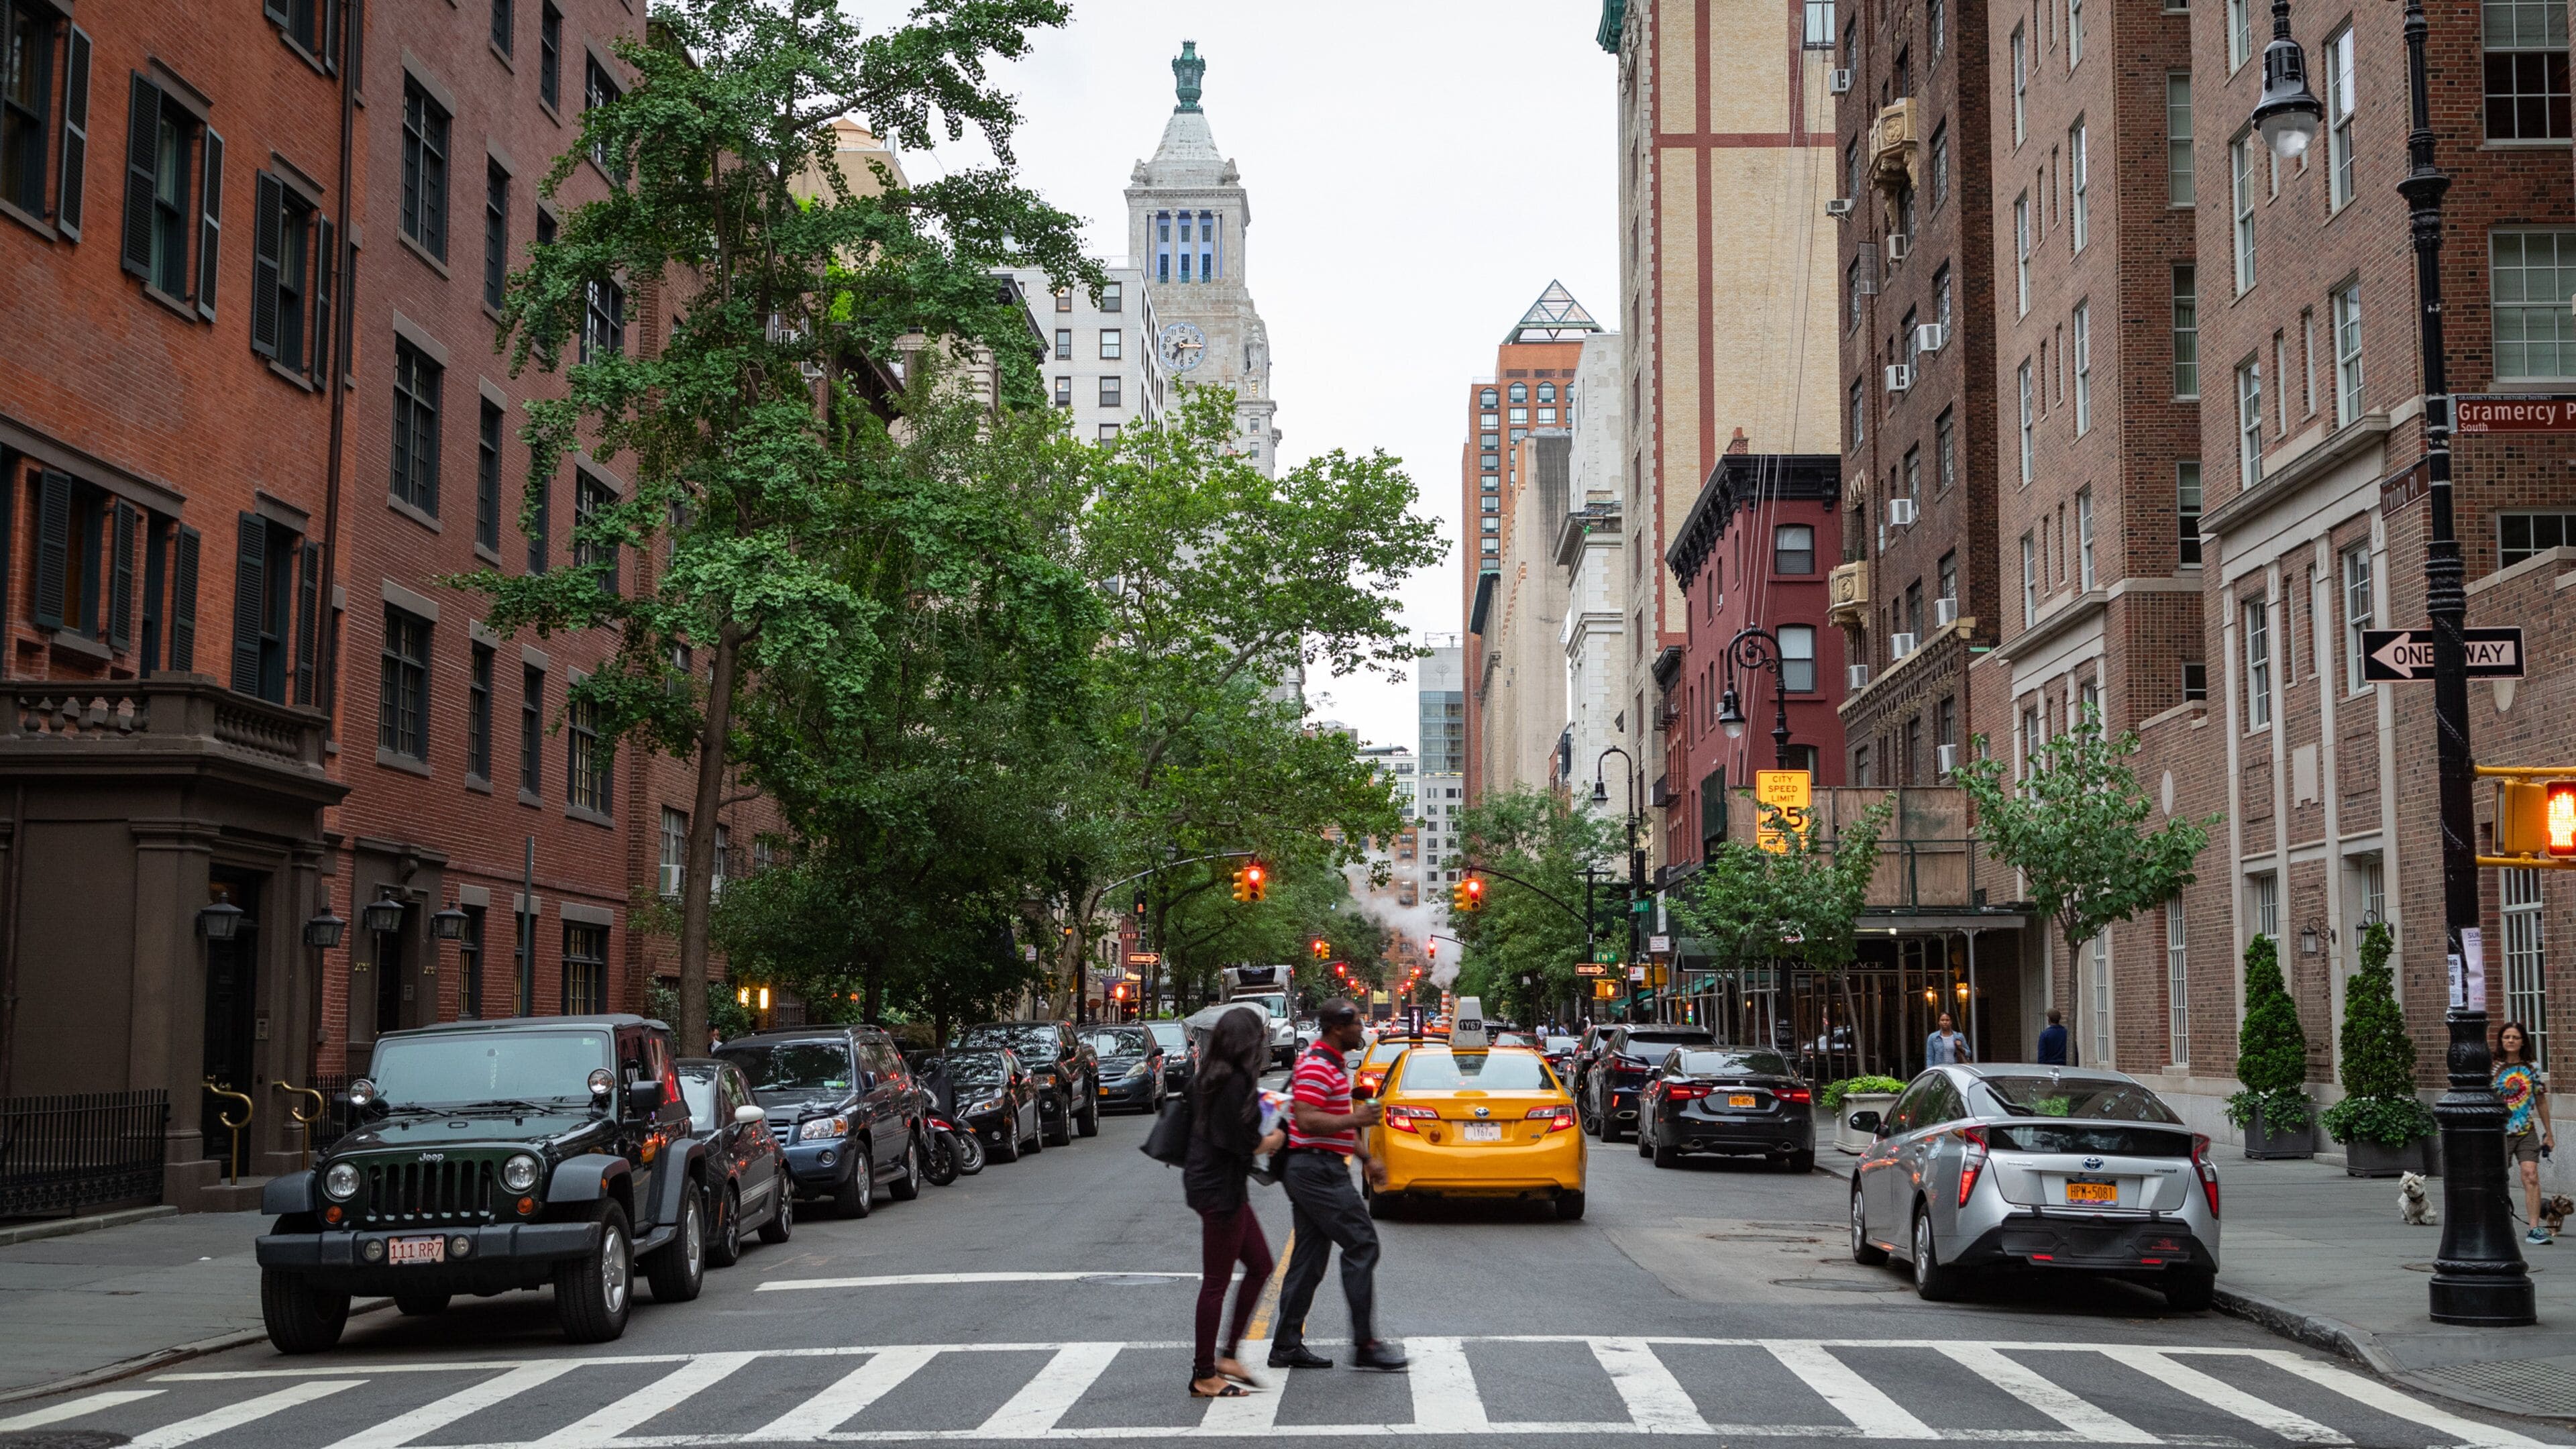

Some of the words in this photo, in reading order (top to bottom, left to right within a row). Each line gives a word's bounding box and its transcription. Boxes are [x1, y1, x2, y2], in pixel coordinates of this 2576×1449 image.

[2459, 403, 2556, 425] Gramercy
[2461, 423, 2488, 431] South
[2382, 484, 2407, 515] Irving
[2409, 472, 2418, 499] Pl
[2394, 645, 2434, 665] ONE
[2465, 644, 2505, 663] WAY
[1460, 1022, 1481, 1030] 1Y67
[419, 1152, 444, 1162] Jeep
[391, 1244, 415, 1259] 111
[419, 1242, 442, 1257] RR7
